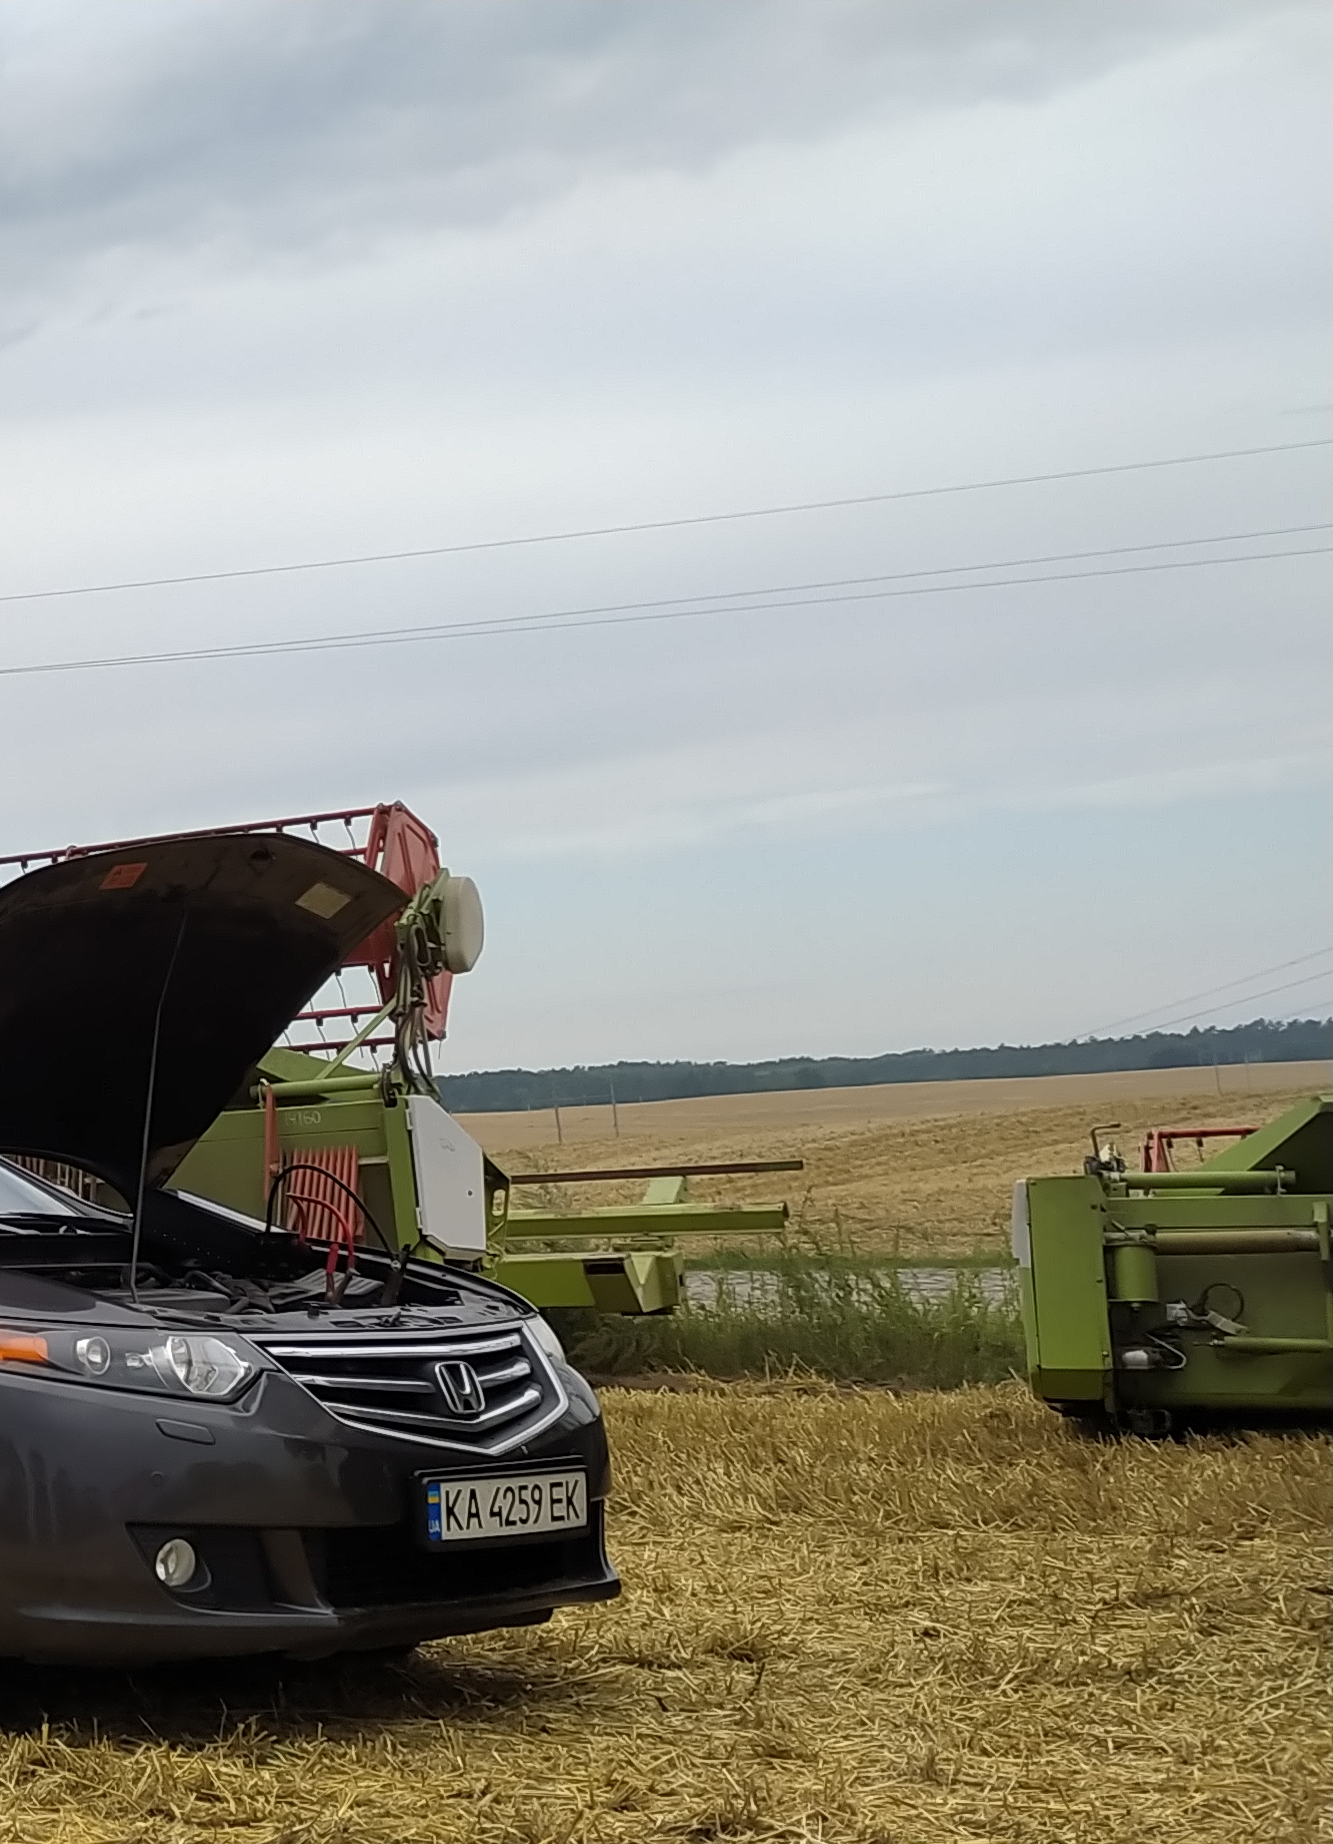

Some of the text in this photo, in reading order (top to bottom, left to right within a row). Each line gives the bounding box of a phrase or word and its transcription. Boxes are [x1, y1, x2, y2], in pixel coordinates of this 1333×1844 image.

[444, 1479, 580, 1532] KA 4259 EK
